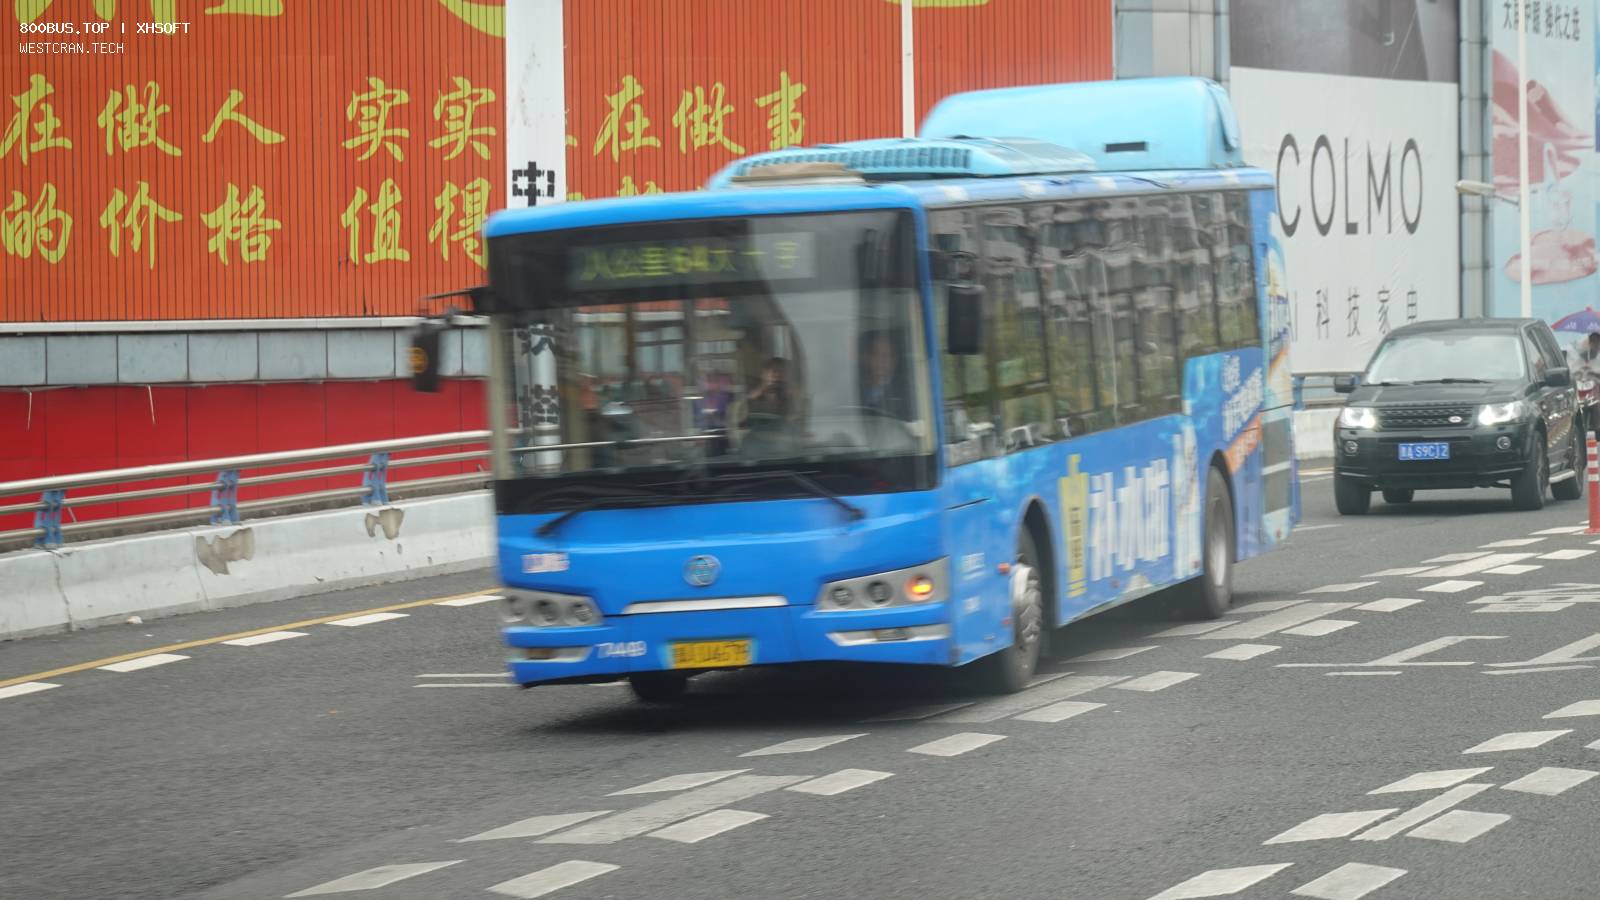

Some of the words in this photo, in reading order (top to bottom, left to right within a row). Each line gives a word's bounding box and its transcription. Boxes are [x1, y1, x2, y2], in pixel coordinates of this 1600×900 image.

[0, 74, 285, 165] 在做人
[0, 181, 283, 270] 的价格
[1276, 133, 1423, 238] COLMO
